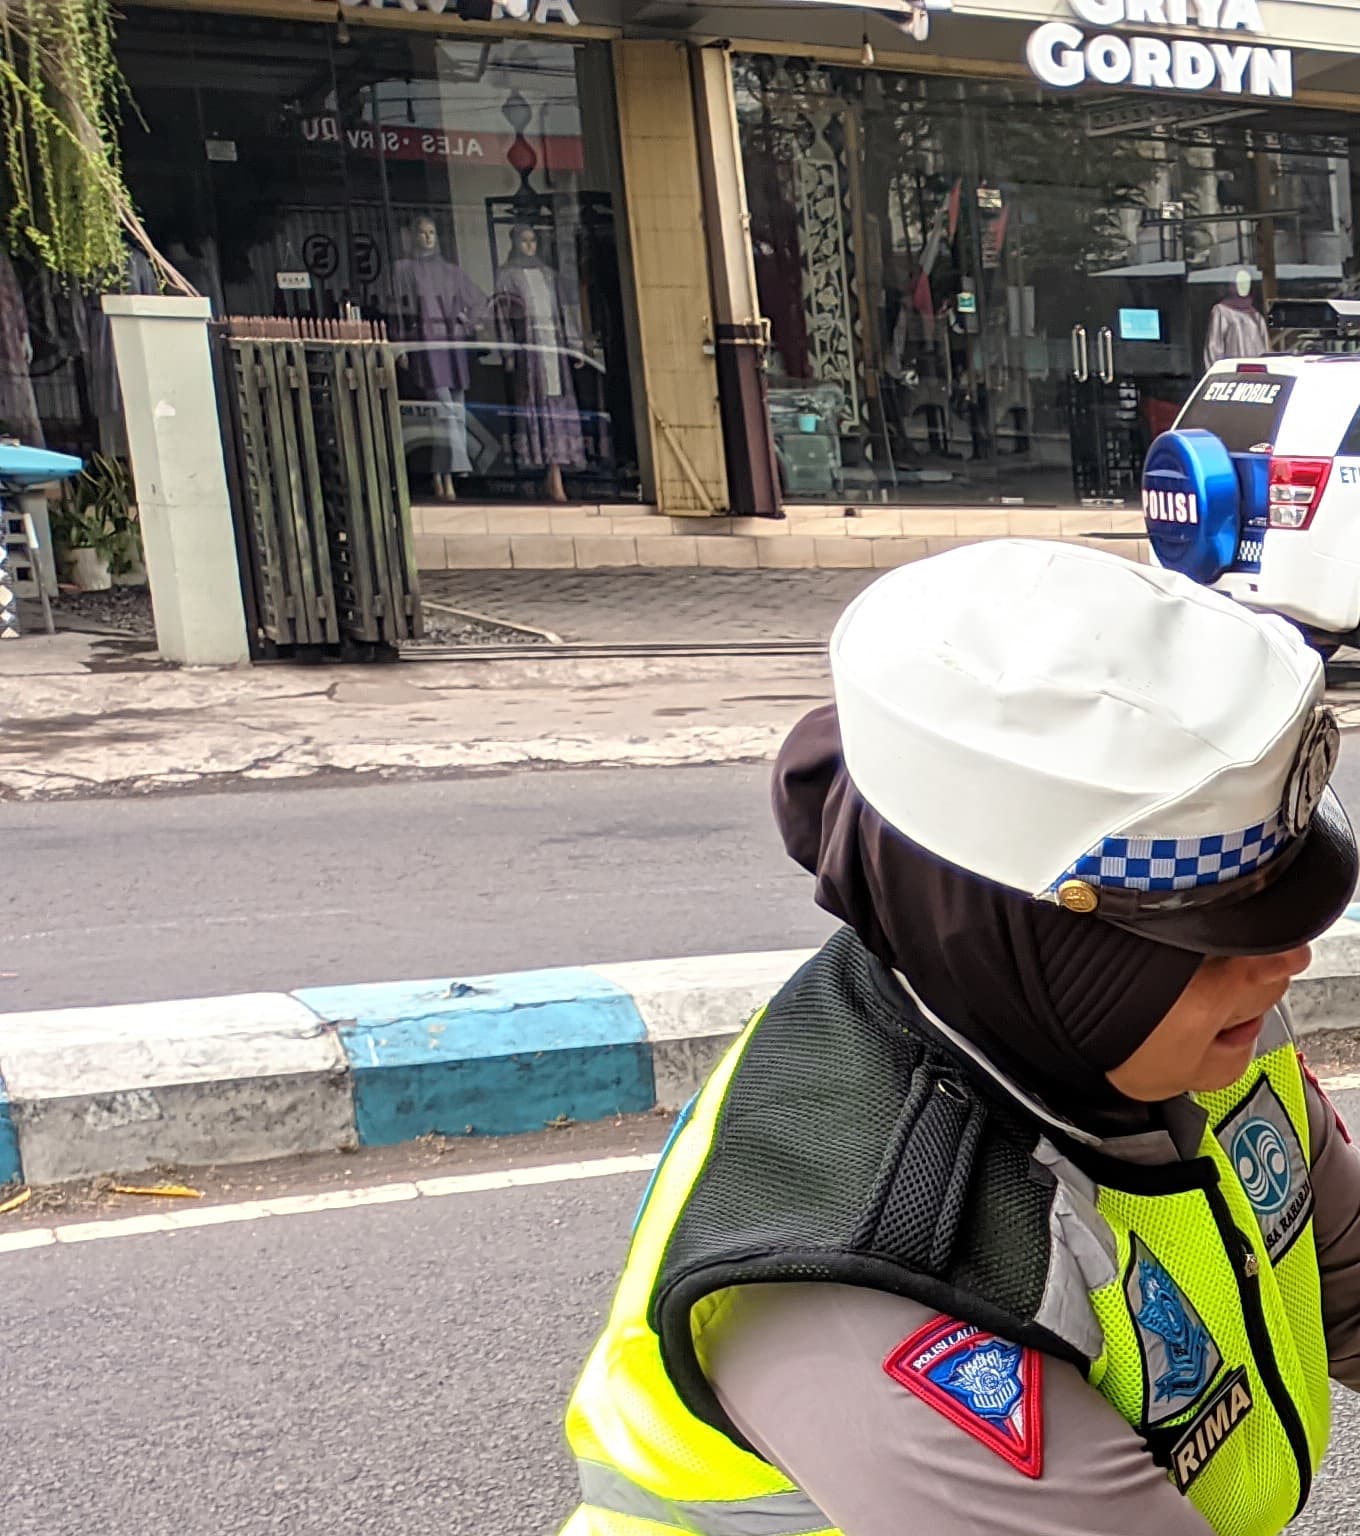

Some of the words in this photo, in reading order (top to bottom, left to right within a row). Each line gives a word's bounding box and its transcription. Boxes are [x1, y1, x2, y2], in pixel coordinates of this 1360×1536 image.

[1026, 21, 1293, 98] GORDYN
[1142, 489, 1199, 525] POLISI
[912, 1339, 949, 1370] POLISI
[1176, 1381, 1252, 1486] RIMA
